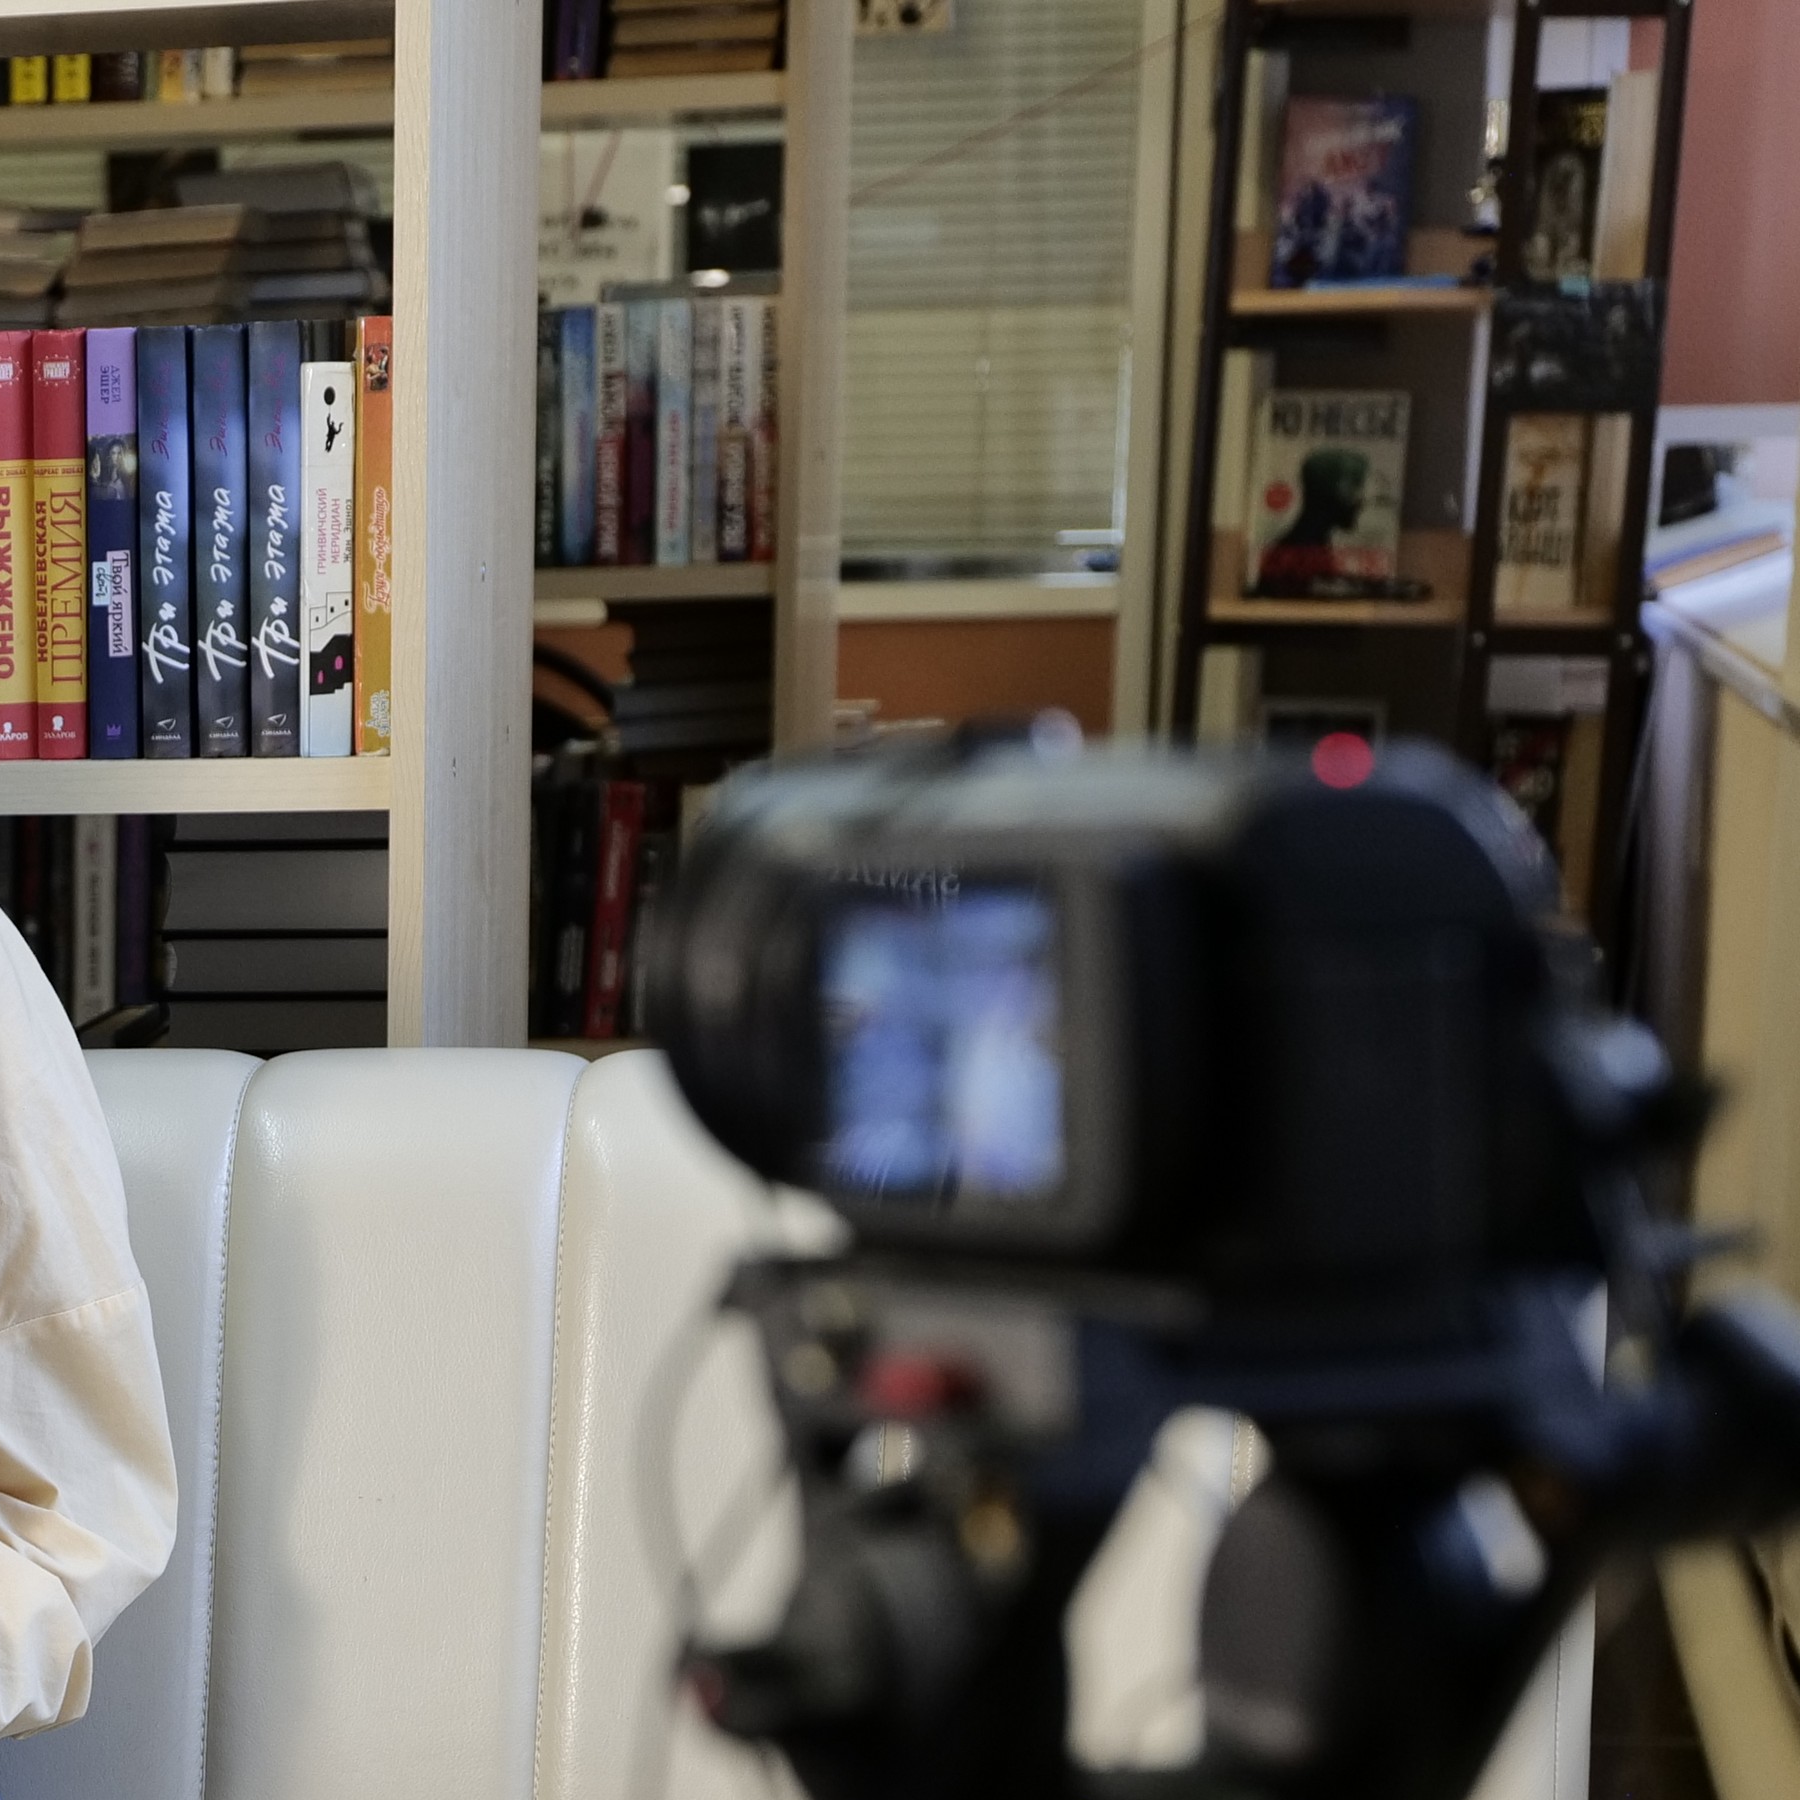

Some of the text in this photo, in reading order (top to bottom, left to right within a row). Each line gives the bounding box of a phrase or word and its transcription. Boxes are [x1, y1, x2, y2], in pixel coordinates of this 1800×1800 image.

[153, 490, 174, 586] этажа
[210, 487, 232, 584] этажа
[264, 483, 287, 583] этажа
[316, 487, 329, 576] ГРИНВИЧСКИЙ
[330, 497, 342, 565] МЕРИДИАН
[35, 500, 48, 663] НОБЕЛЕВСКАЯ
[50, 488, 84, 686] ПРЕМИЯ
